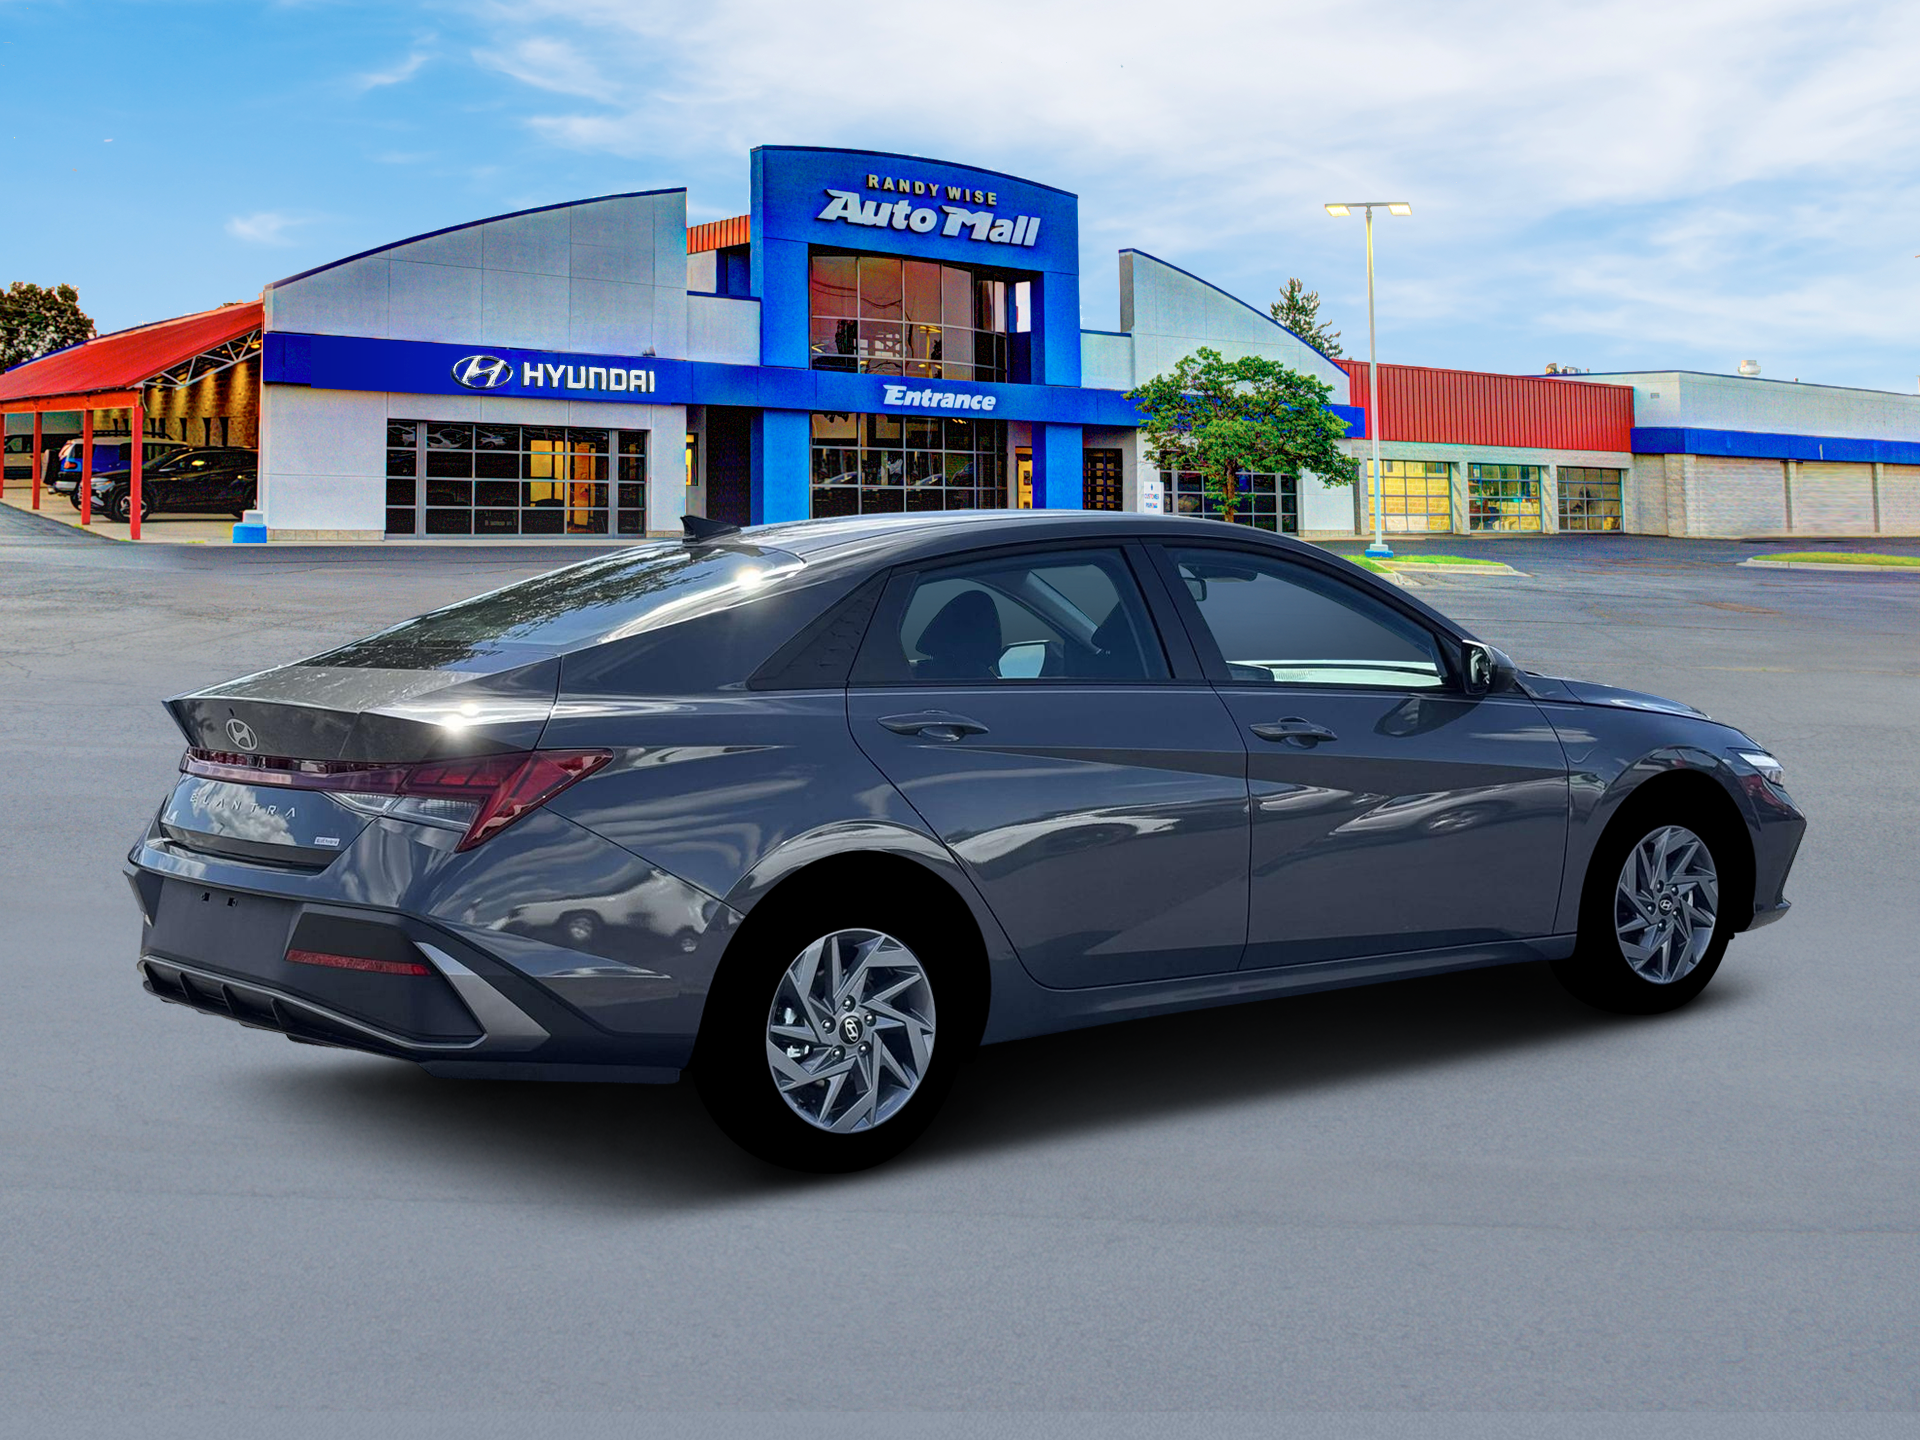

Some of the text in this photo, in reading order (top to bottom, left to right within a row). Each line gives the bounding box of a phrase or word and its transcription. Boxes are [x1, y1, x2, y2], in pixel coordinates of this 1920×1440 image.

[866, 173, 998, 206] RANDY WISE
[816, 188, 1042, 247] Auto Mall
[520, 361, 656, 394] HYUNDAI
[882, 384, 997, 412] Entrance
